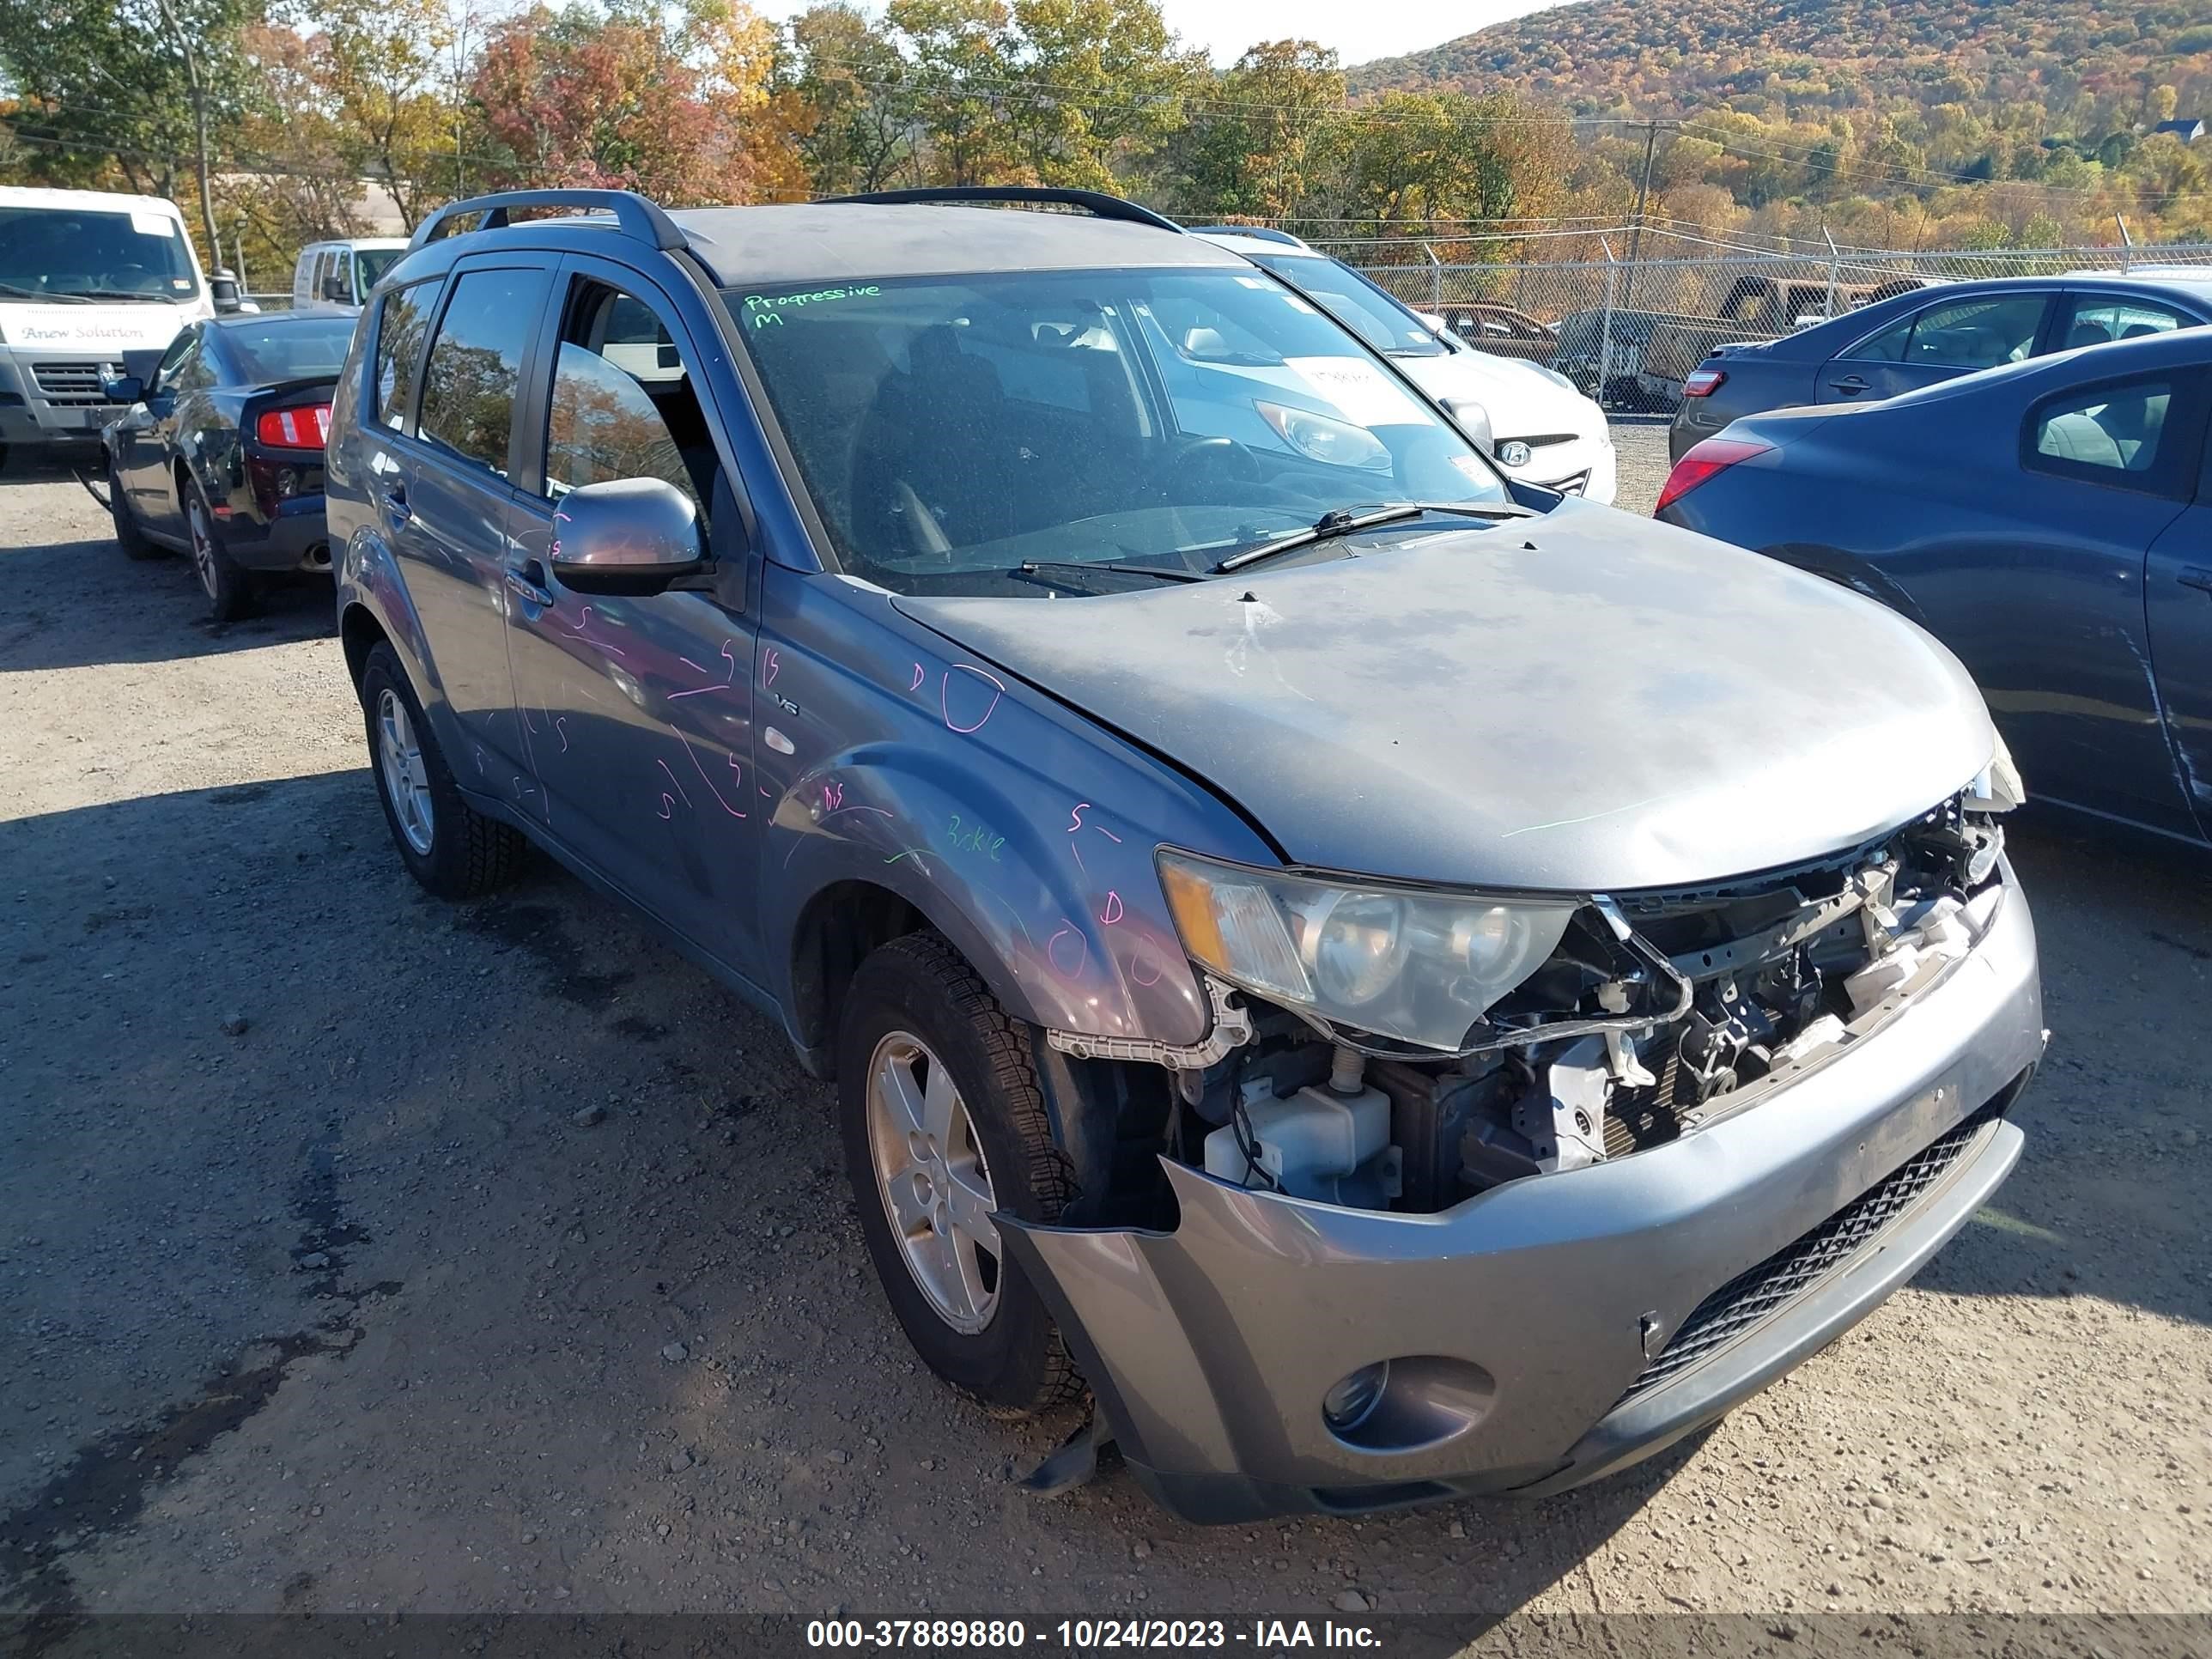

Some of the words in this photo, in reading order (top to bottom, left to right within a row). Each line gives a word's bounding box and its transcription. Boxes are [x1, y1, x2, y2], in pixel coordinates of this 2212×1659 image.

[744, 286, 881, 311] Progressive
[21, 327, 69, 339] Anew
[75, 324, 144, 338] Solution
[755, 313, 783, 328] M
[775, 693, 800, 716] V6
[1067, 803, 1091, 832] S
[1099, 890, 1124, 926] D
